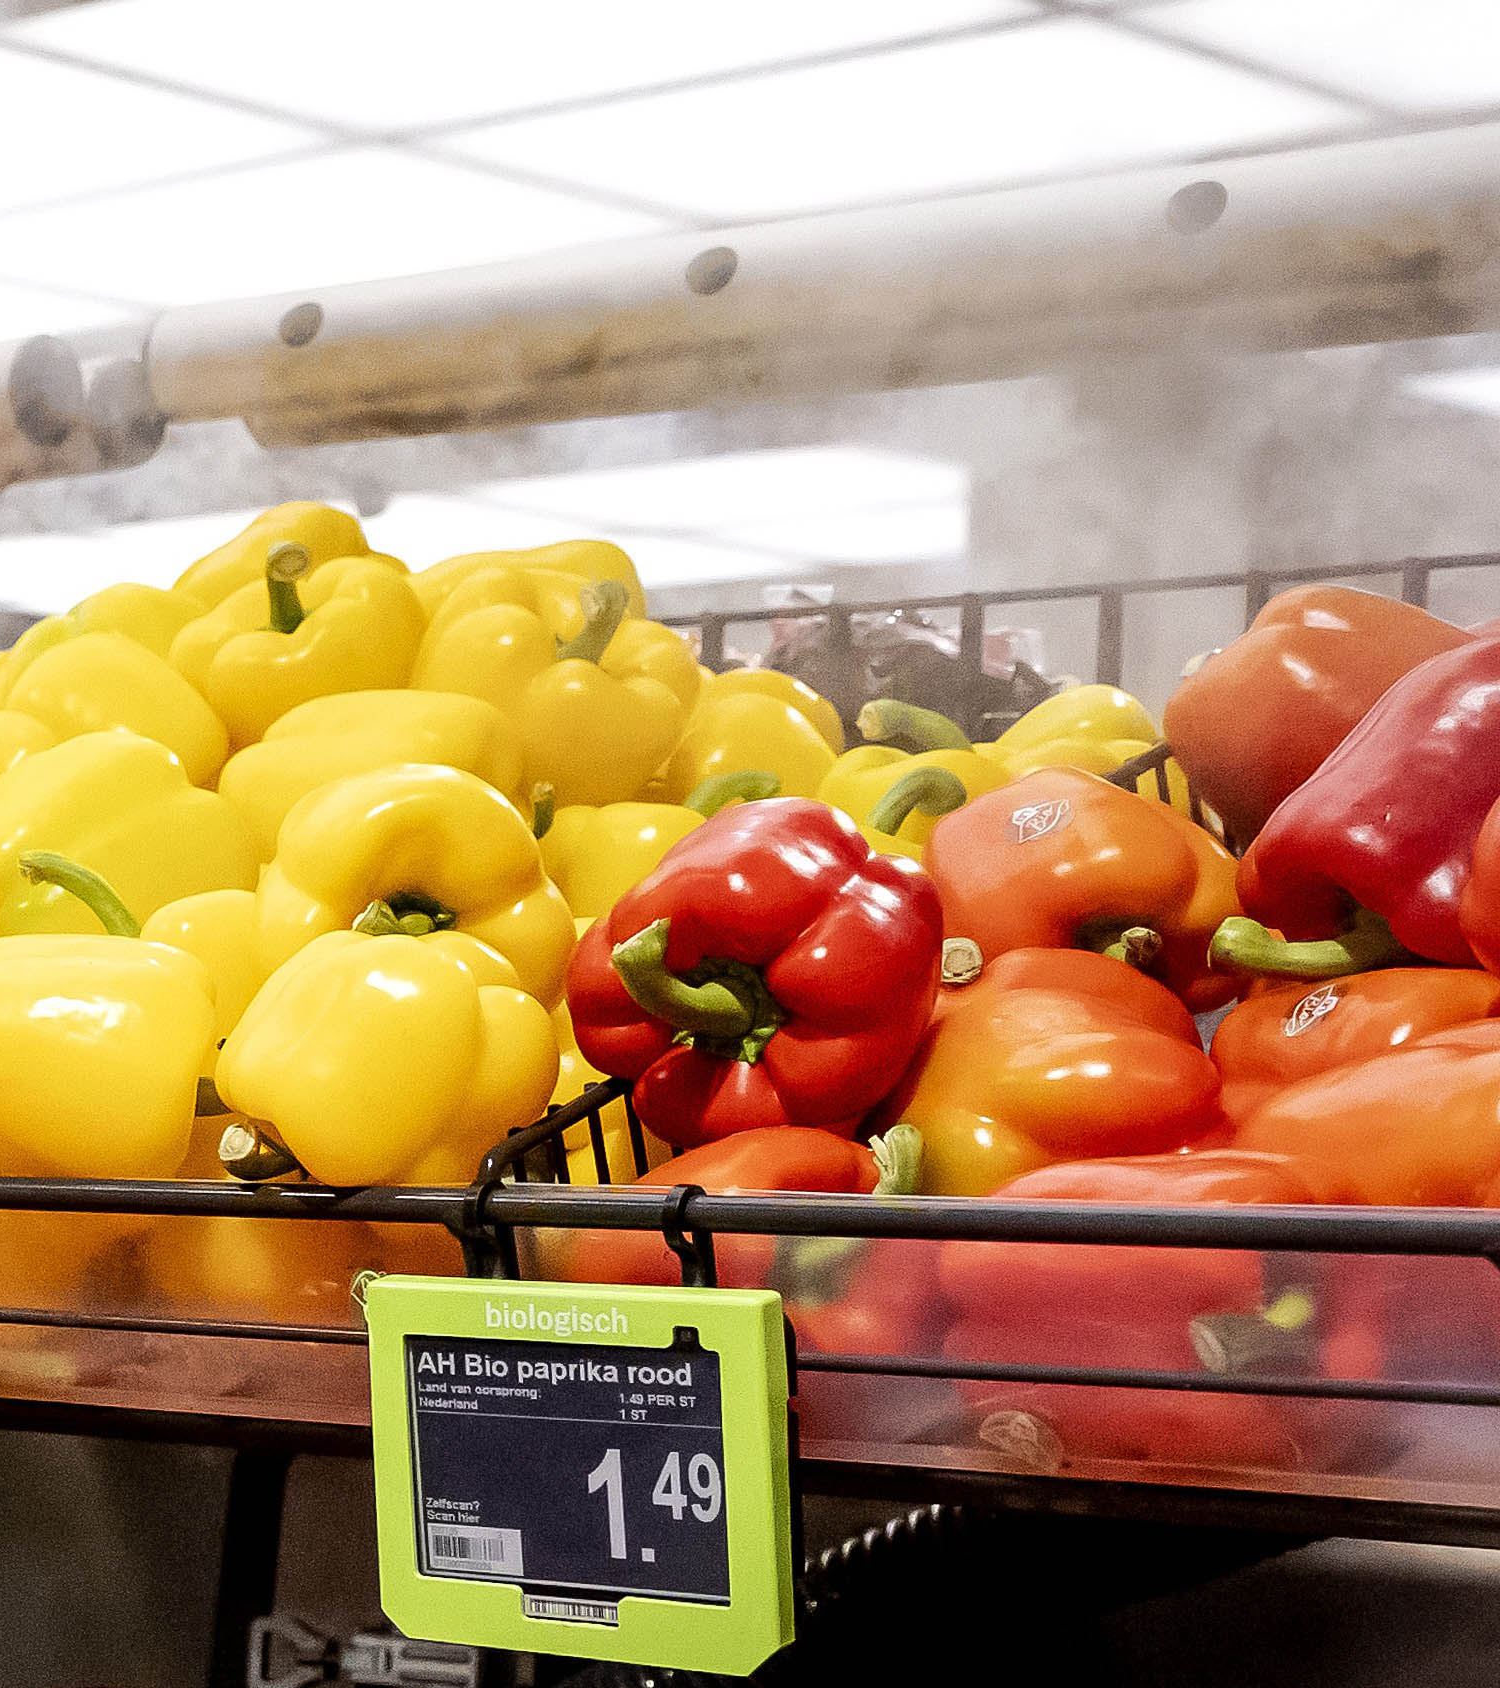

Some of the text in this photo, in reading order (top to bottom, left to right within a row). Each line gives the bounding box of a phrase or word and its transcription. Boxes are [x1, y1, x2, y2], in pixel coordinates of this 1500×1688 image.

[485, 1301, 629, 1337] biologisch
[417, 1351, 692, 1386] AH Bio paprika rood
[418, 1382, 447, 1393] Land
[451, 1384, 472, 1394] van
[419, 1397, 479, 1410] Nederland
[620, 1393, 696, 1408] 1.49 PER ST
[619, 1409, 648, 1420] 1 ST
[426, 1497, 481, 1511] Zelfscan?
[588, 1449, 722, 1562] 1.49
[427, 1509, 481, 1523] Scan hier
